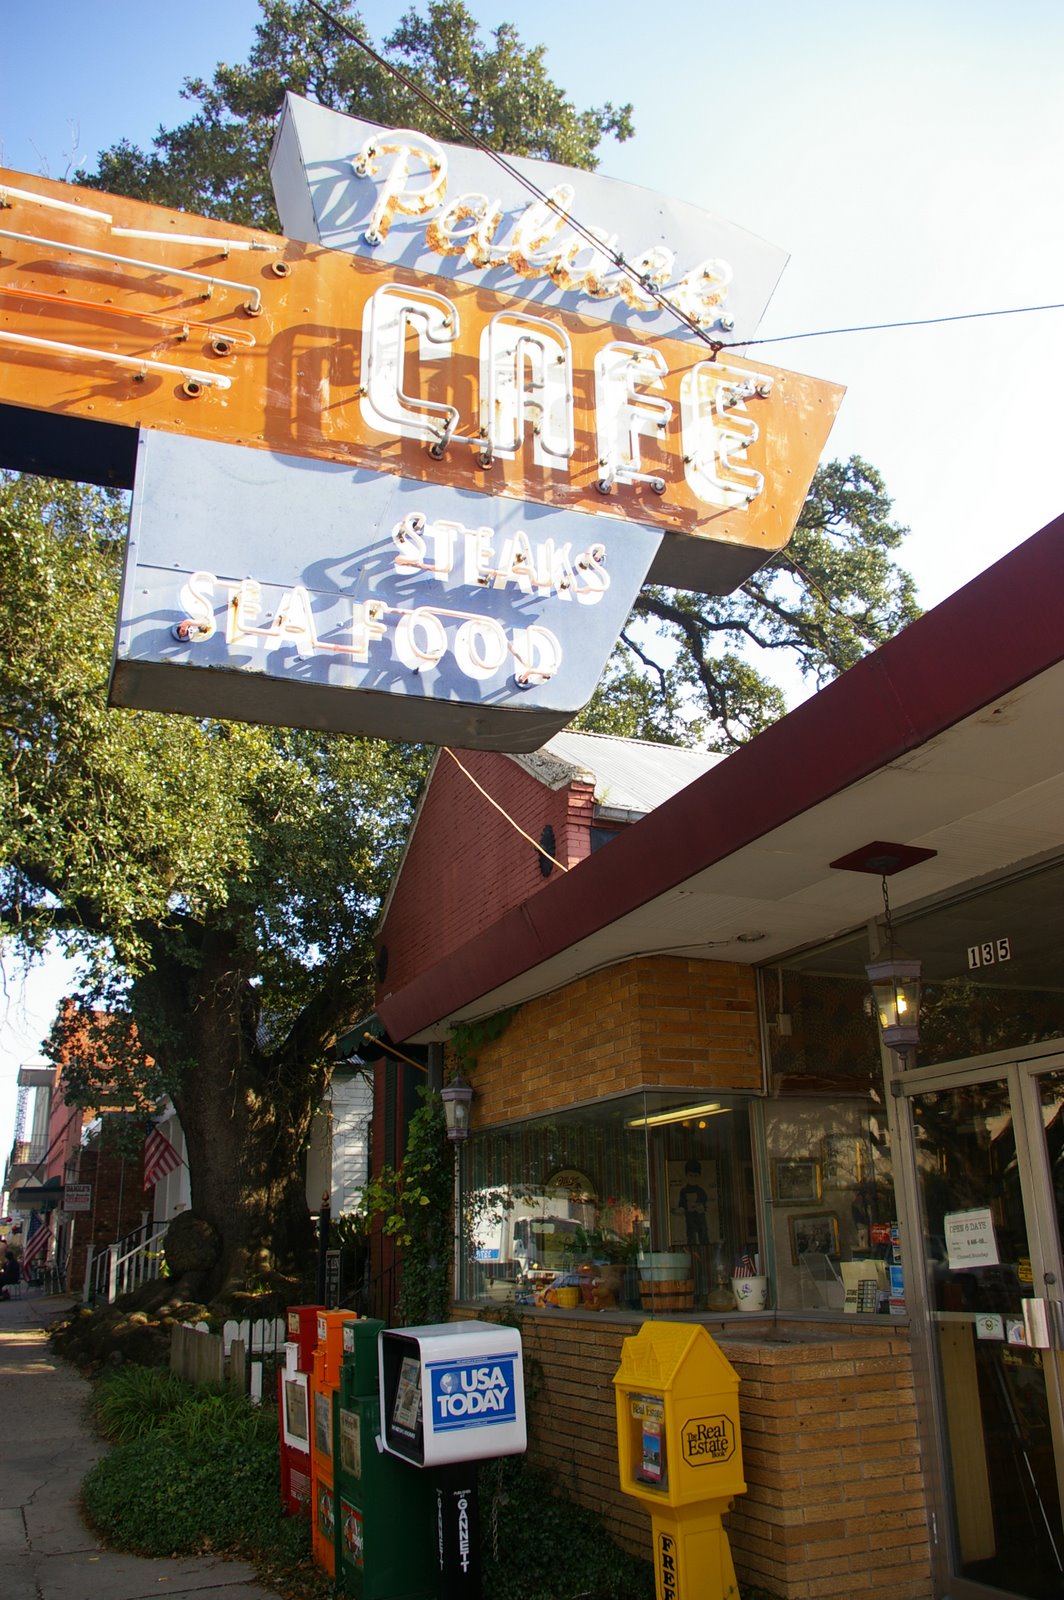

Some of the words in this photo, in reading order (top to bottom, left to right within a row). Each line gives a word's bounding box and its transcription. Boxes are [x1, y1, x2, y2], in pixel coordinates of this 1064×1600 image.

[352, 129, 734, 330] Palace
[359, 283, 775, 510] CAFE
[392, 512, 611, 606] STEAKS
[177, 571, 315, 657] SEA
[352, 599, 563, 687] FOOD
[969, 940, 1009, 967] 135
[949, 1223, 964, 1233] OPEN
[965, 1223, 969, 1231] 6
[970, 1221, 987, 1231] DAYS
[461, 1366, 507, 1392] USA
[437, 1387, 509, 1418] TODAY
[696, 1420, 726, 1441] Real
[688, 1437, 729, 1456] Estate
[457, 1498, 470, 1573] GANNETT
